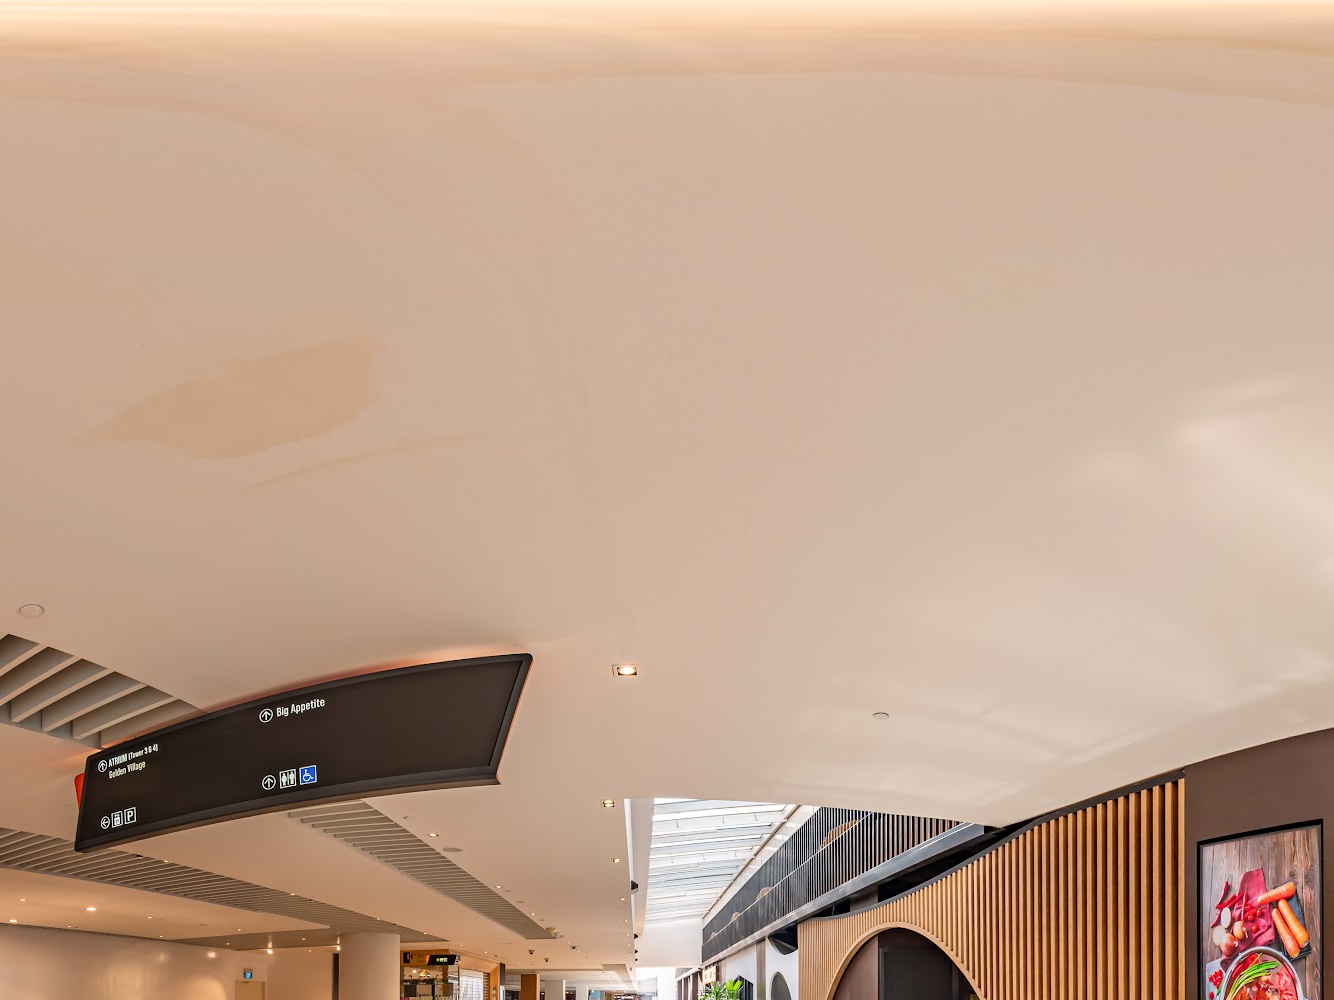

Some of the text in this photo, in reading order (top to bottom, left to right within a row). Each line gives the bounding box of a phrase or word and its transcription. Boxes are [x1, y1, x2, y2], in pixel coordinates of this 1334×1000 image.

[276, 698, 326, 718] Big Appetite
[108, 753, 128, 768] ATRIUM
[128, 749, 144, 760] (Tower
[144, 746, 148, 754] 3
[152, 744, 158, 752] 4)
[108, 761, 146, 779] Golden Village
